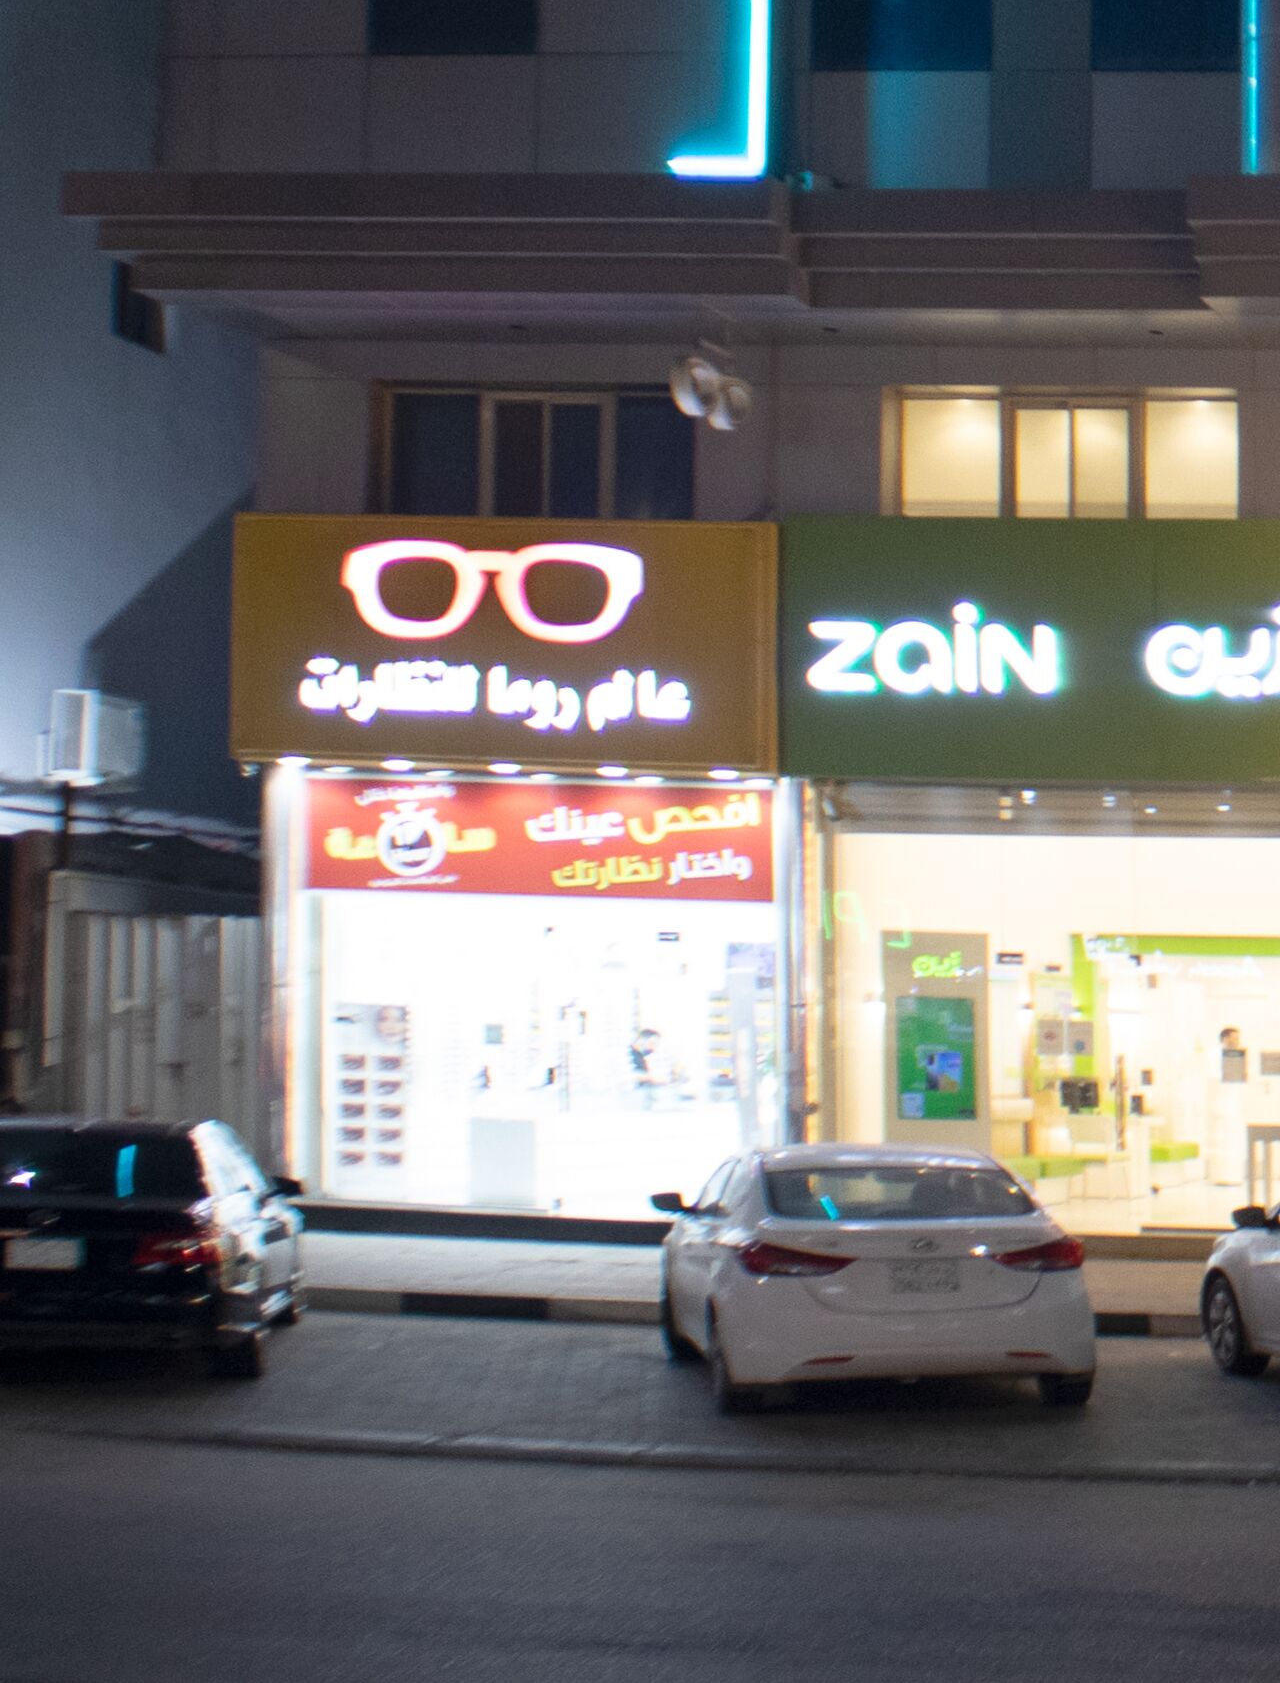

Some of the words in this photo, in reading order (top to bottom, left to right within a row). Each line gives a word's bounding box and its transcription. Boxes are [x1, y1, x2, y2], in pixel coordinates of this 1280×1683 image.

[525, 805, 627, 846] عينك
[627, 792, 763, 845] افحص
[551, 856, 665, 890] نظارتك
[667, 849, 754, 885] واختار
